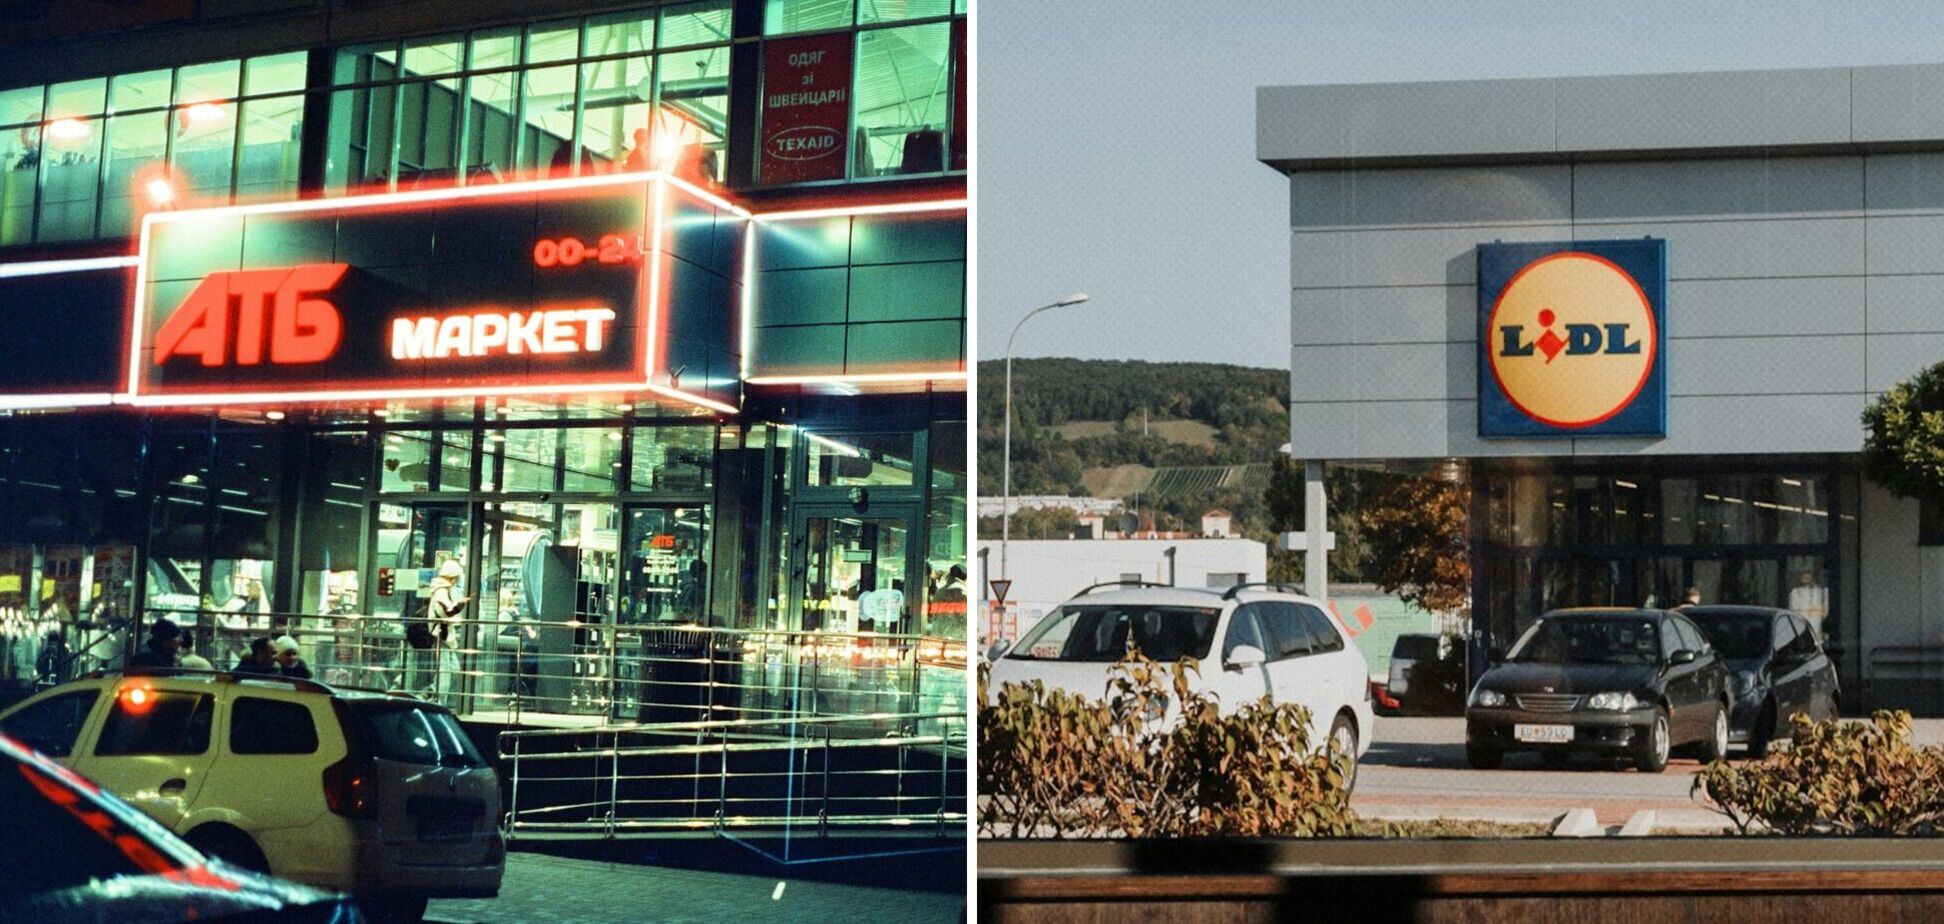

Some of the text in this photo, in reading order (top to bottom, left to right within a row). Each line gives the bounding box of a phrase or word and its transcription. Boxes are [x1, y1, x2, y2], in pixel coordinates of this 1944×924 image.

[788, 51, 826, 67] ОДЯГ
[776, 135, 835, 151] TEXAID
[154, 263, 350, 367] АТБ
[391, 308, 616, 360] МАРКЕТ
